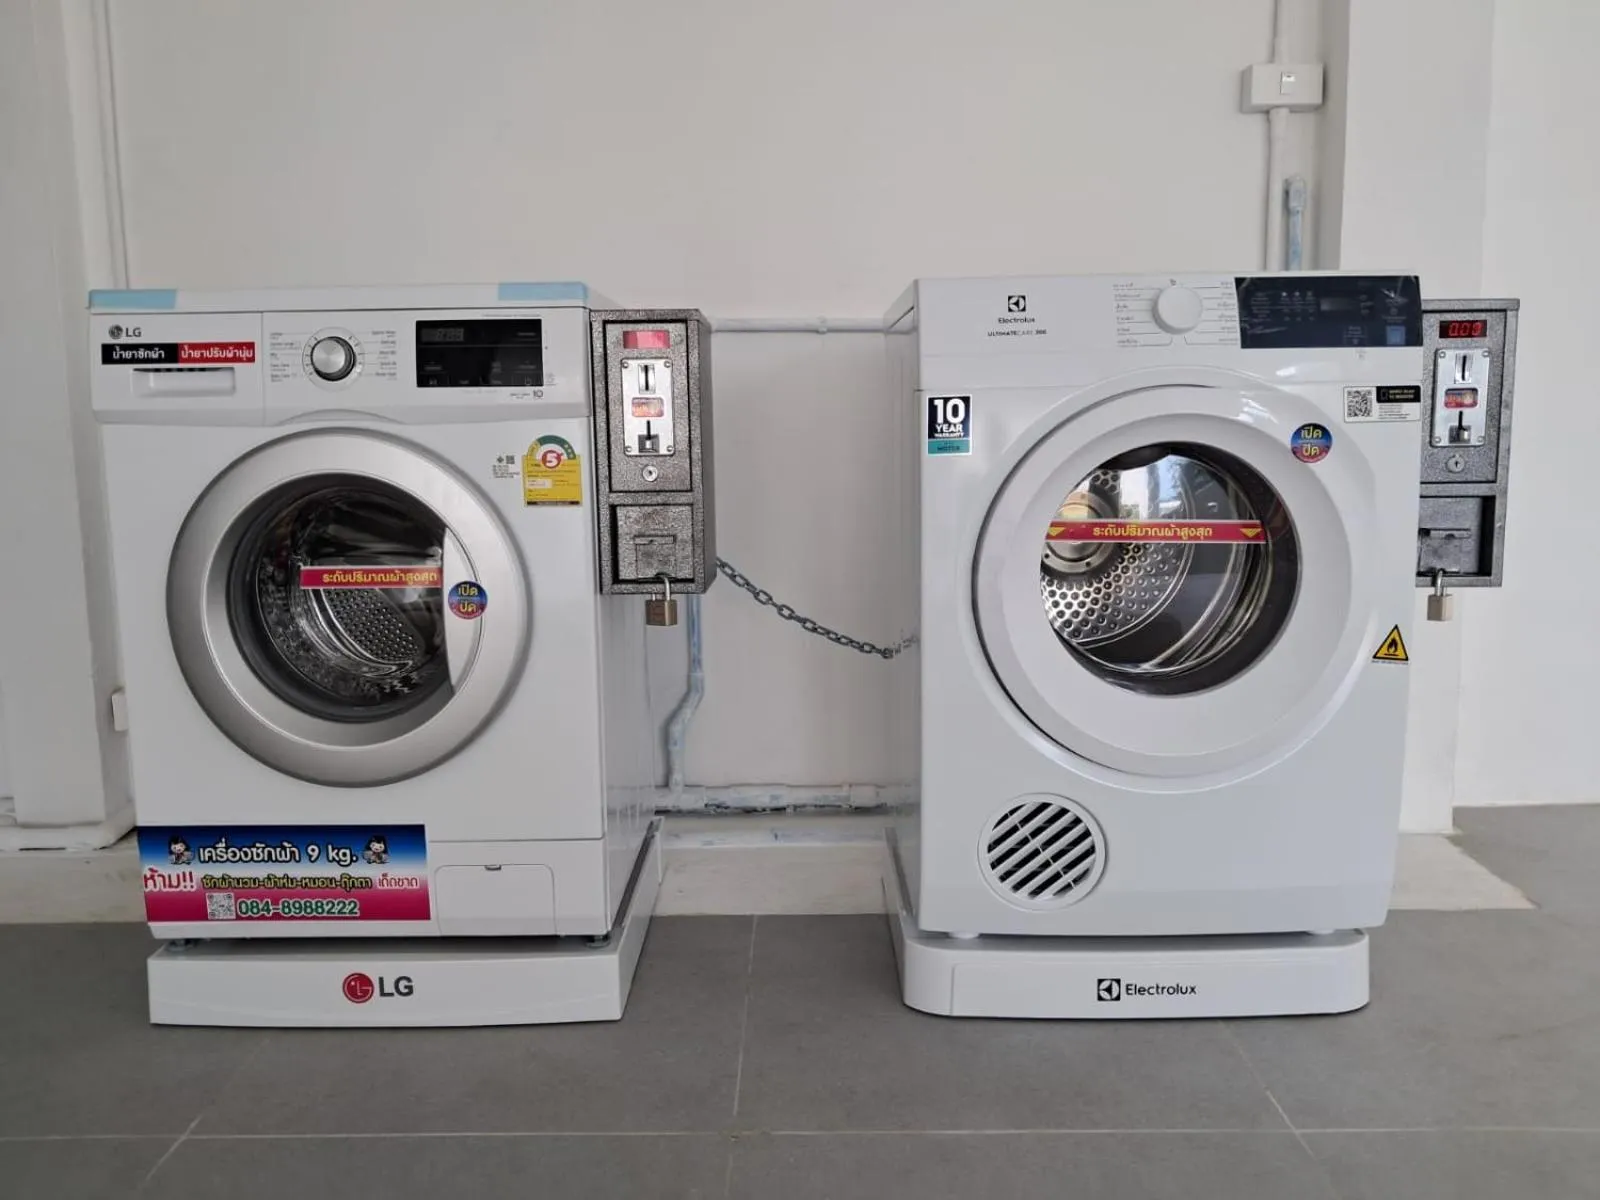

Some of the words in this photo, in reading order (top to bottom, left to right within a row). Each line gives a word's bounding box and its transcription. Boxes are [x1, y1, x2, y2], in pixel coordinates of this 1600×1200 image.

[125, 327, 142, 338] LG
[112, 344, 165, 359] น้ำยาซักผ้า
[181, 344, 254, 361] น้ำยาปรับผ้านุ่ม
[933, 398, 966, 424] 10
[935, 423, 964, 433] YEAR
[1301, 426, 1322, 439] เปิด
[1302, 442, 1320, 456] ปิด
[1092, 524, 1213, 541] ระดับปริมาณผ้าสูงสุด
[322, 570, 438, 586] ระดับปริมาณผ้าสูงสุด
[458, 584, 478, 596] เปิด
[460, 599, 477, 612] ปิด
[199, 837, 299, 862] เครื่องซักผ้า
[306, 845, 320, 861] 9
[328, 845, 358, 866] kg.
[143, 867, 194, 890] ห้าม!!
[378, 872, 418, 888] เด็ดขาด
[238, 900, 358, 916] 084-8988222
[378, 976, 414, 997] LG
[1125, 983, 1197, 996] Electrolux
